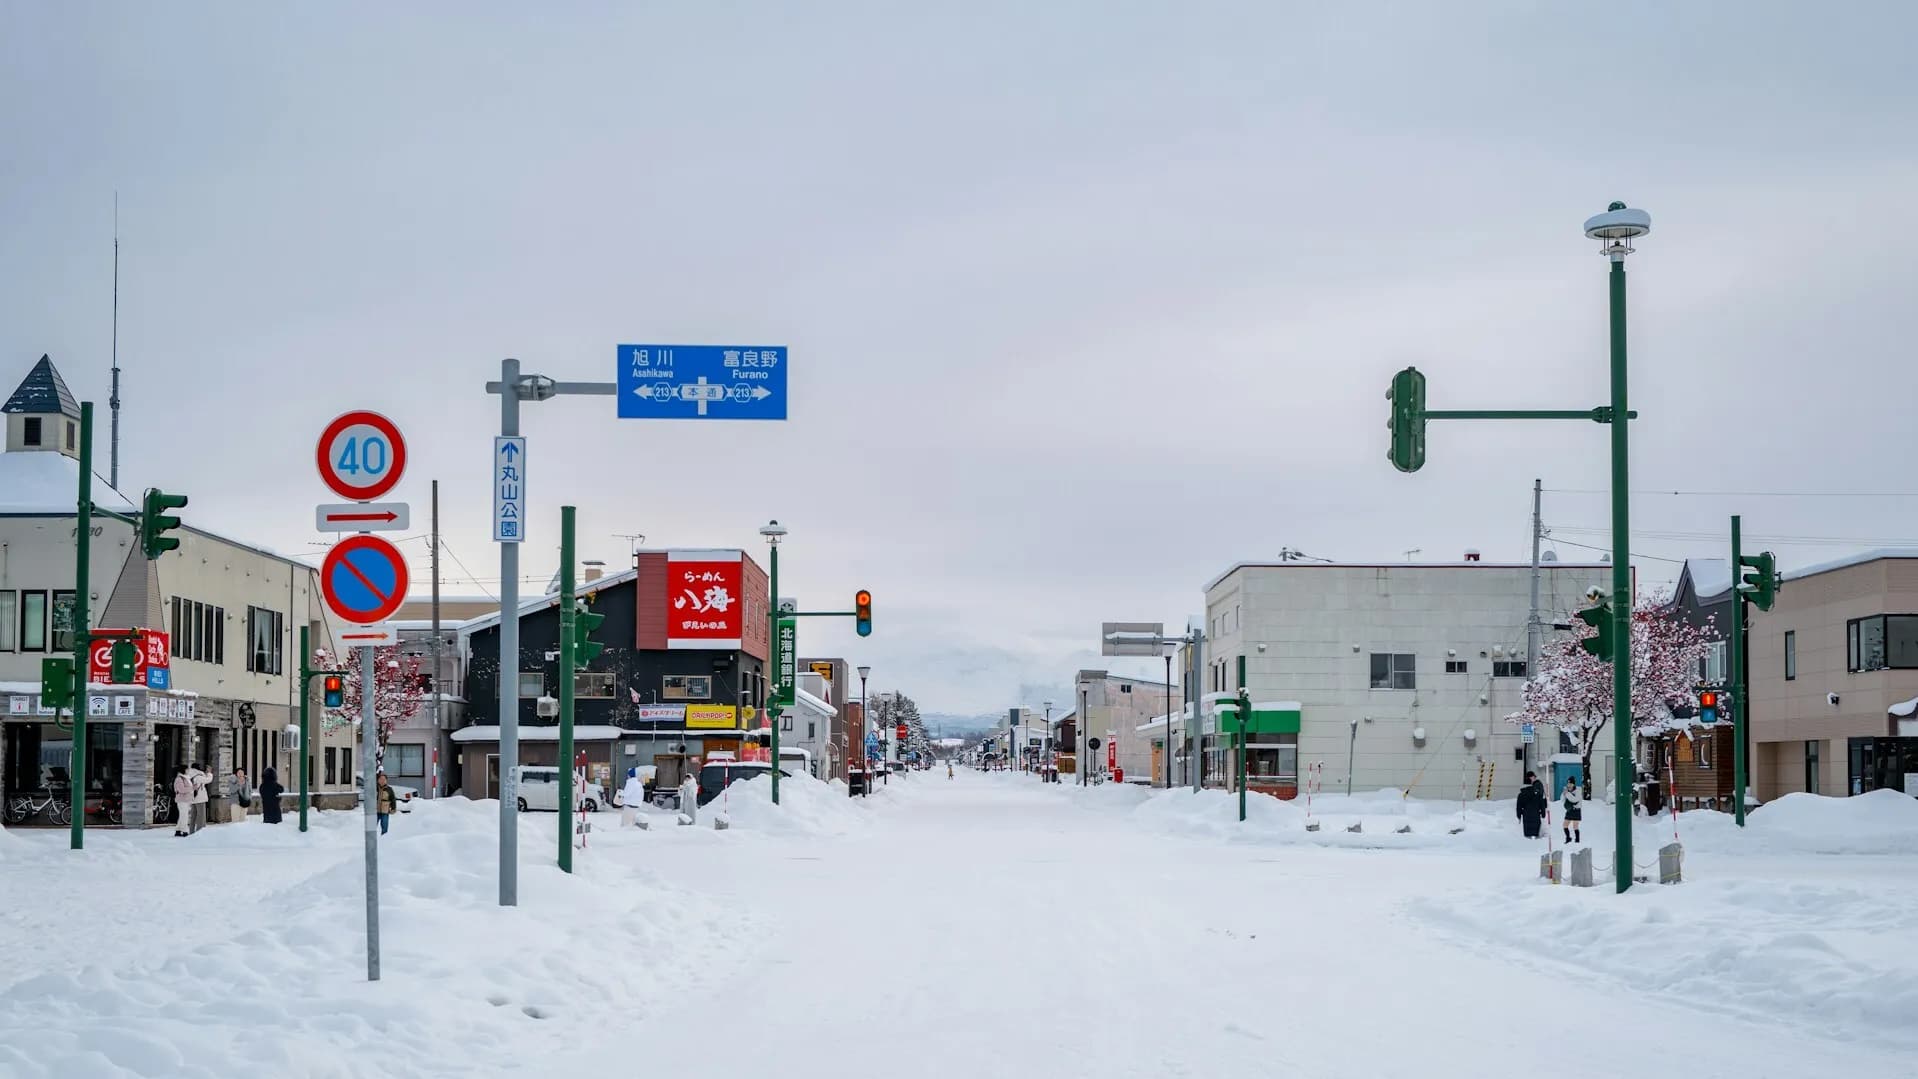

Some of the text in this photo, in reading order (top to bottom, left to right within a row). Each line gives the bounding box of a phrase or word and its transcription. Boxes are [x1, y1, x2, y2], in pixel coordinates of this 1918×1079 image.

[632, 349, 673, 367] 旭川
[723, 350, 778, 368] 富良野
[632, 368, 674, 379] Asahikawa
[732, 369, 769, 379] Furano
[655, 387, 669, 397] 213
[688, 387, 717, 397] 本通
[735, 387, 750, 398] 213
[337, 436, 386, 475] 40
[501, 465, 519, 537] 丸山公園
[71, 526, 104, 538] 130
[684, 571, 726, 583] らーめん
[780, 627, 793, 688] 北海道銀行
